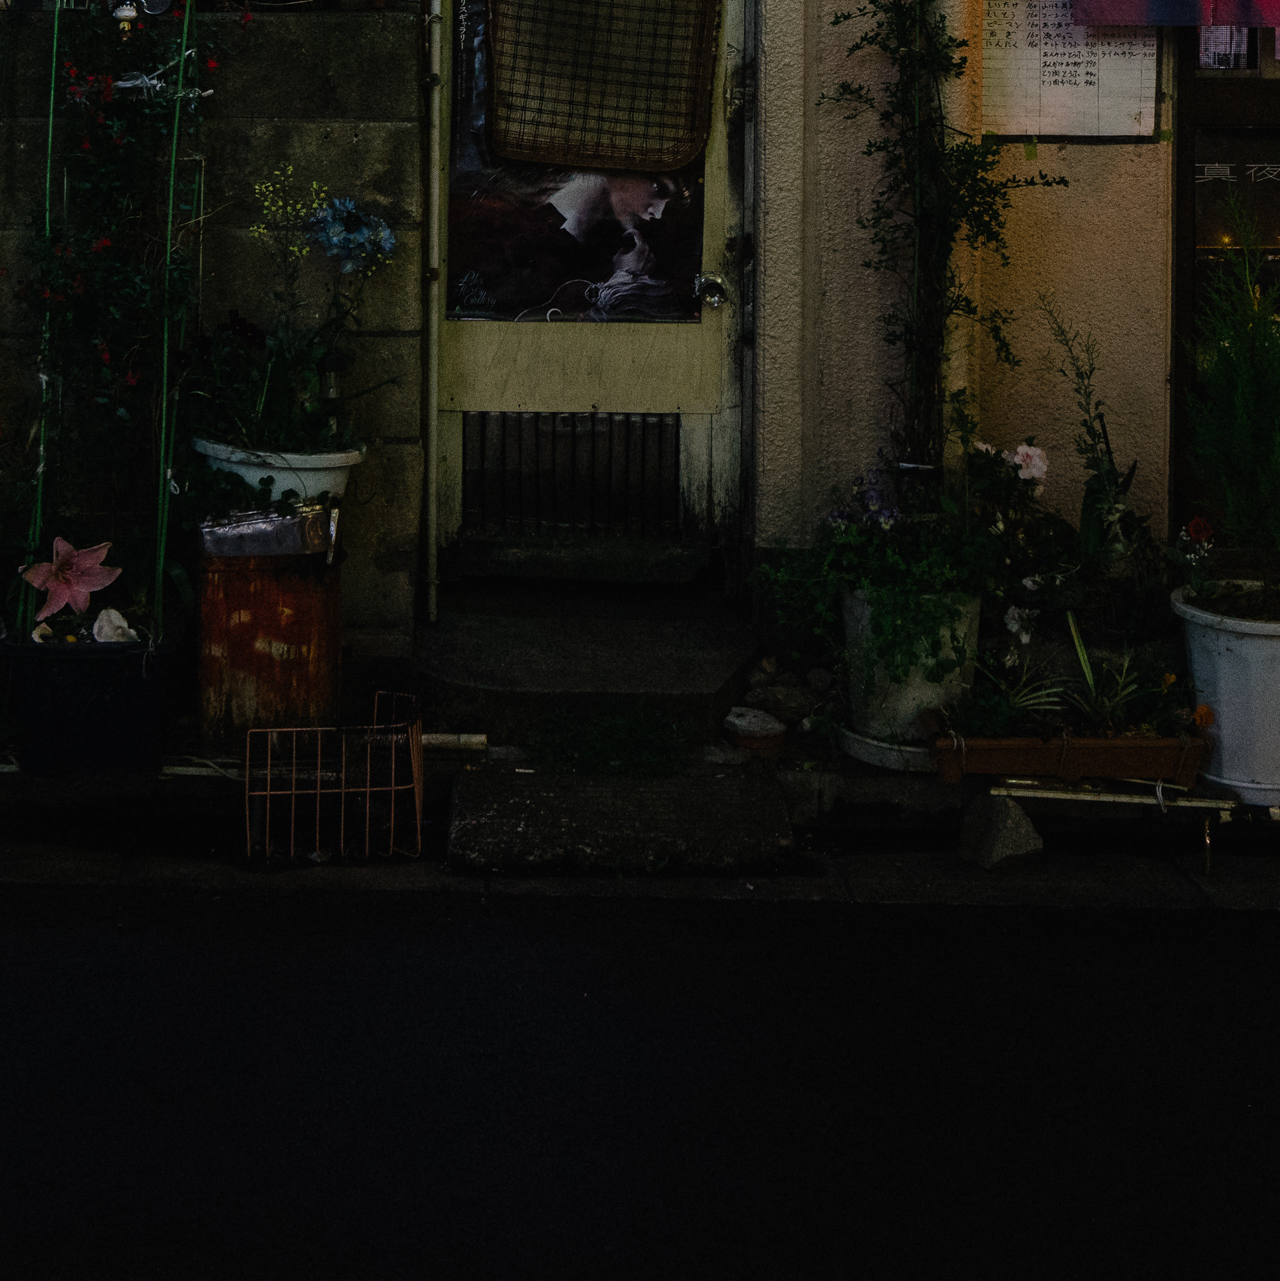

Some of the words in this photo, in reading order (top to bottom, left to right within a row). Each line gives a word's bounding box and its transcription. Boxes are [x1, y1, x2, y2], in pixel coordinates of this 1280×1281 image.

[987, 21, 1023, 29] ピーマン
[986, 40, 1019, 48] にんにく
[1101, 51, 1141, 59] ライムサワー
